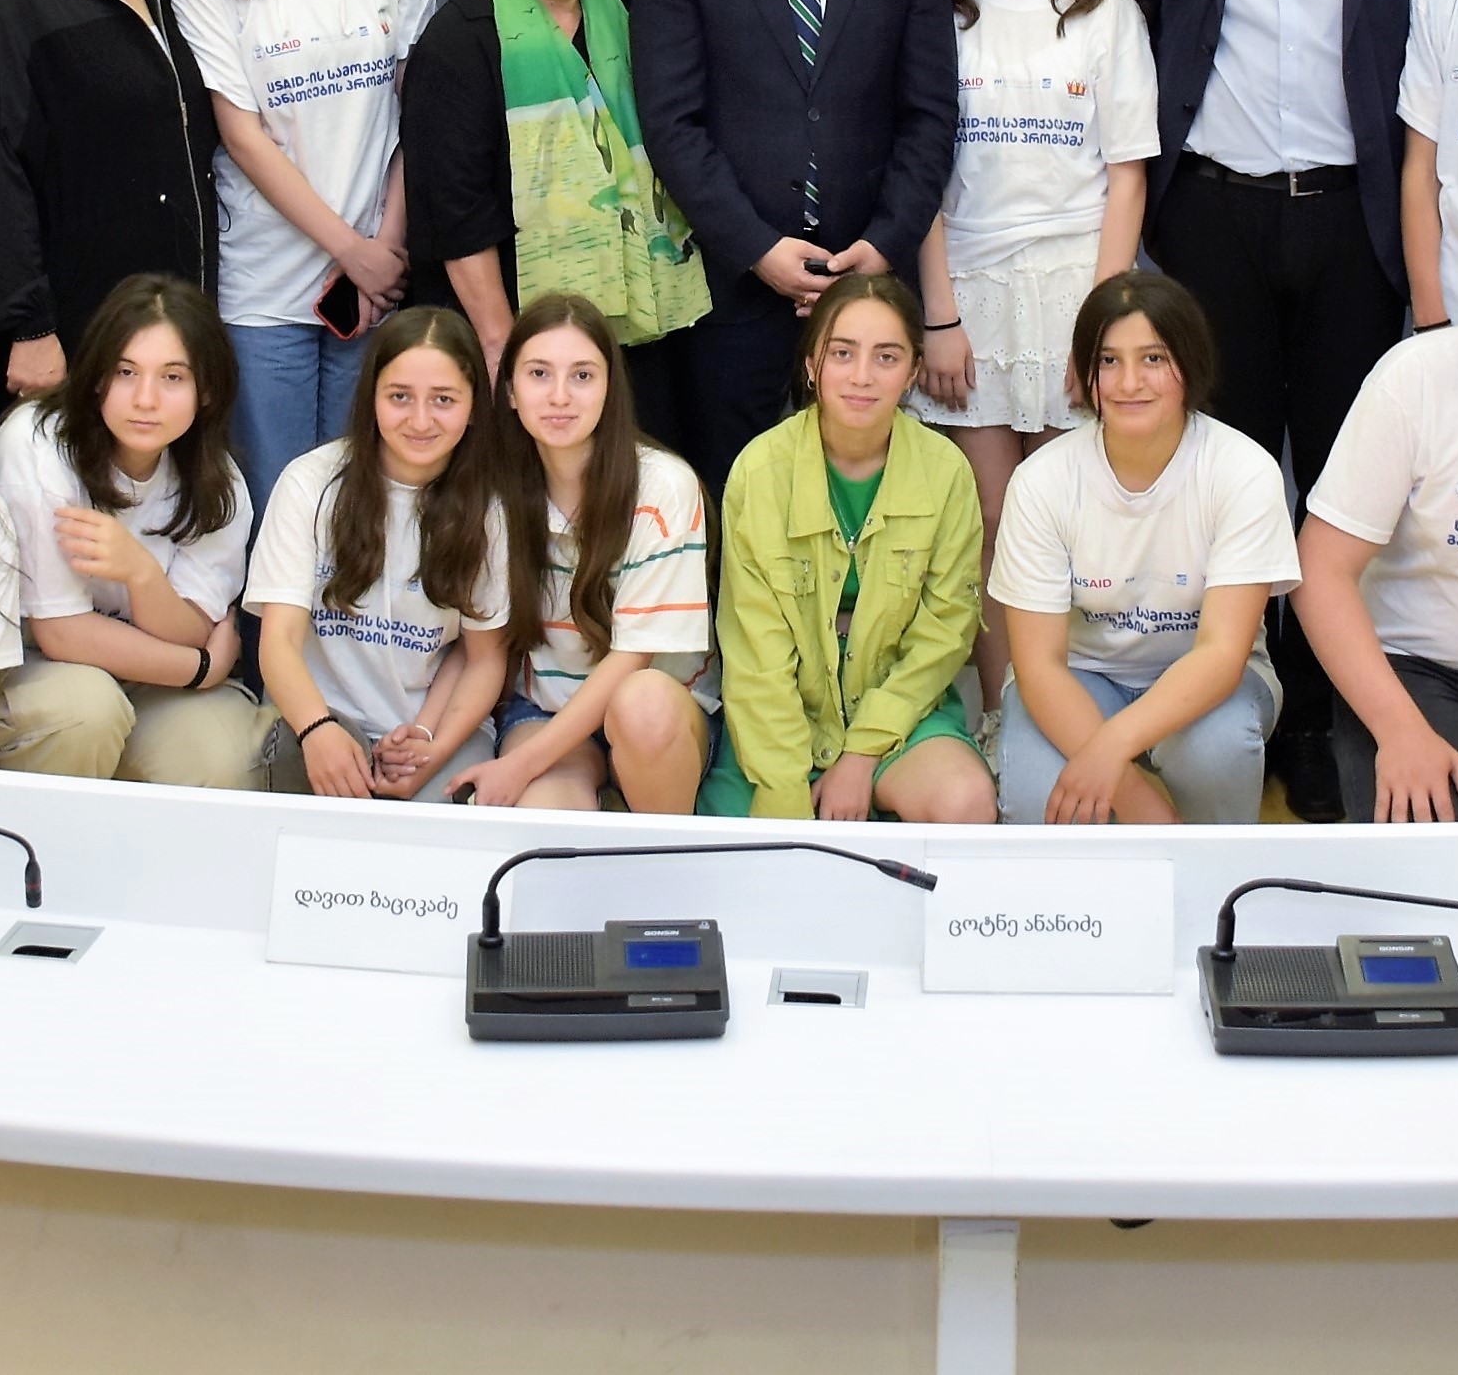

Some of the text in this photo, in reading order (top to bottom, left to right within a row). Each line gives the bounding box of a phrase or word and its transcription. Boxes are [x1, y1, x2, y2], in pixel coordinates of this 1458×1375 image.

[265, 39, 301, 55] USAID
[266, 71, 325, 94] USAID-ის
[958, 77, 984, 88] SAID
[1074, 577, 1112, 588] USAID
[294, 889, 459, 920] დავით ბაციკაძე
[948, 913, 1103, 938] ცოტნე ანანიძე
